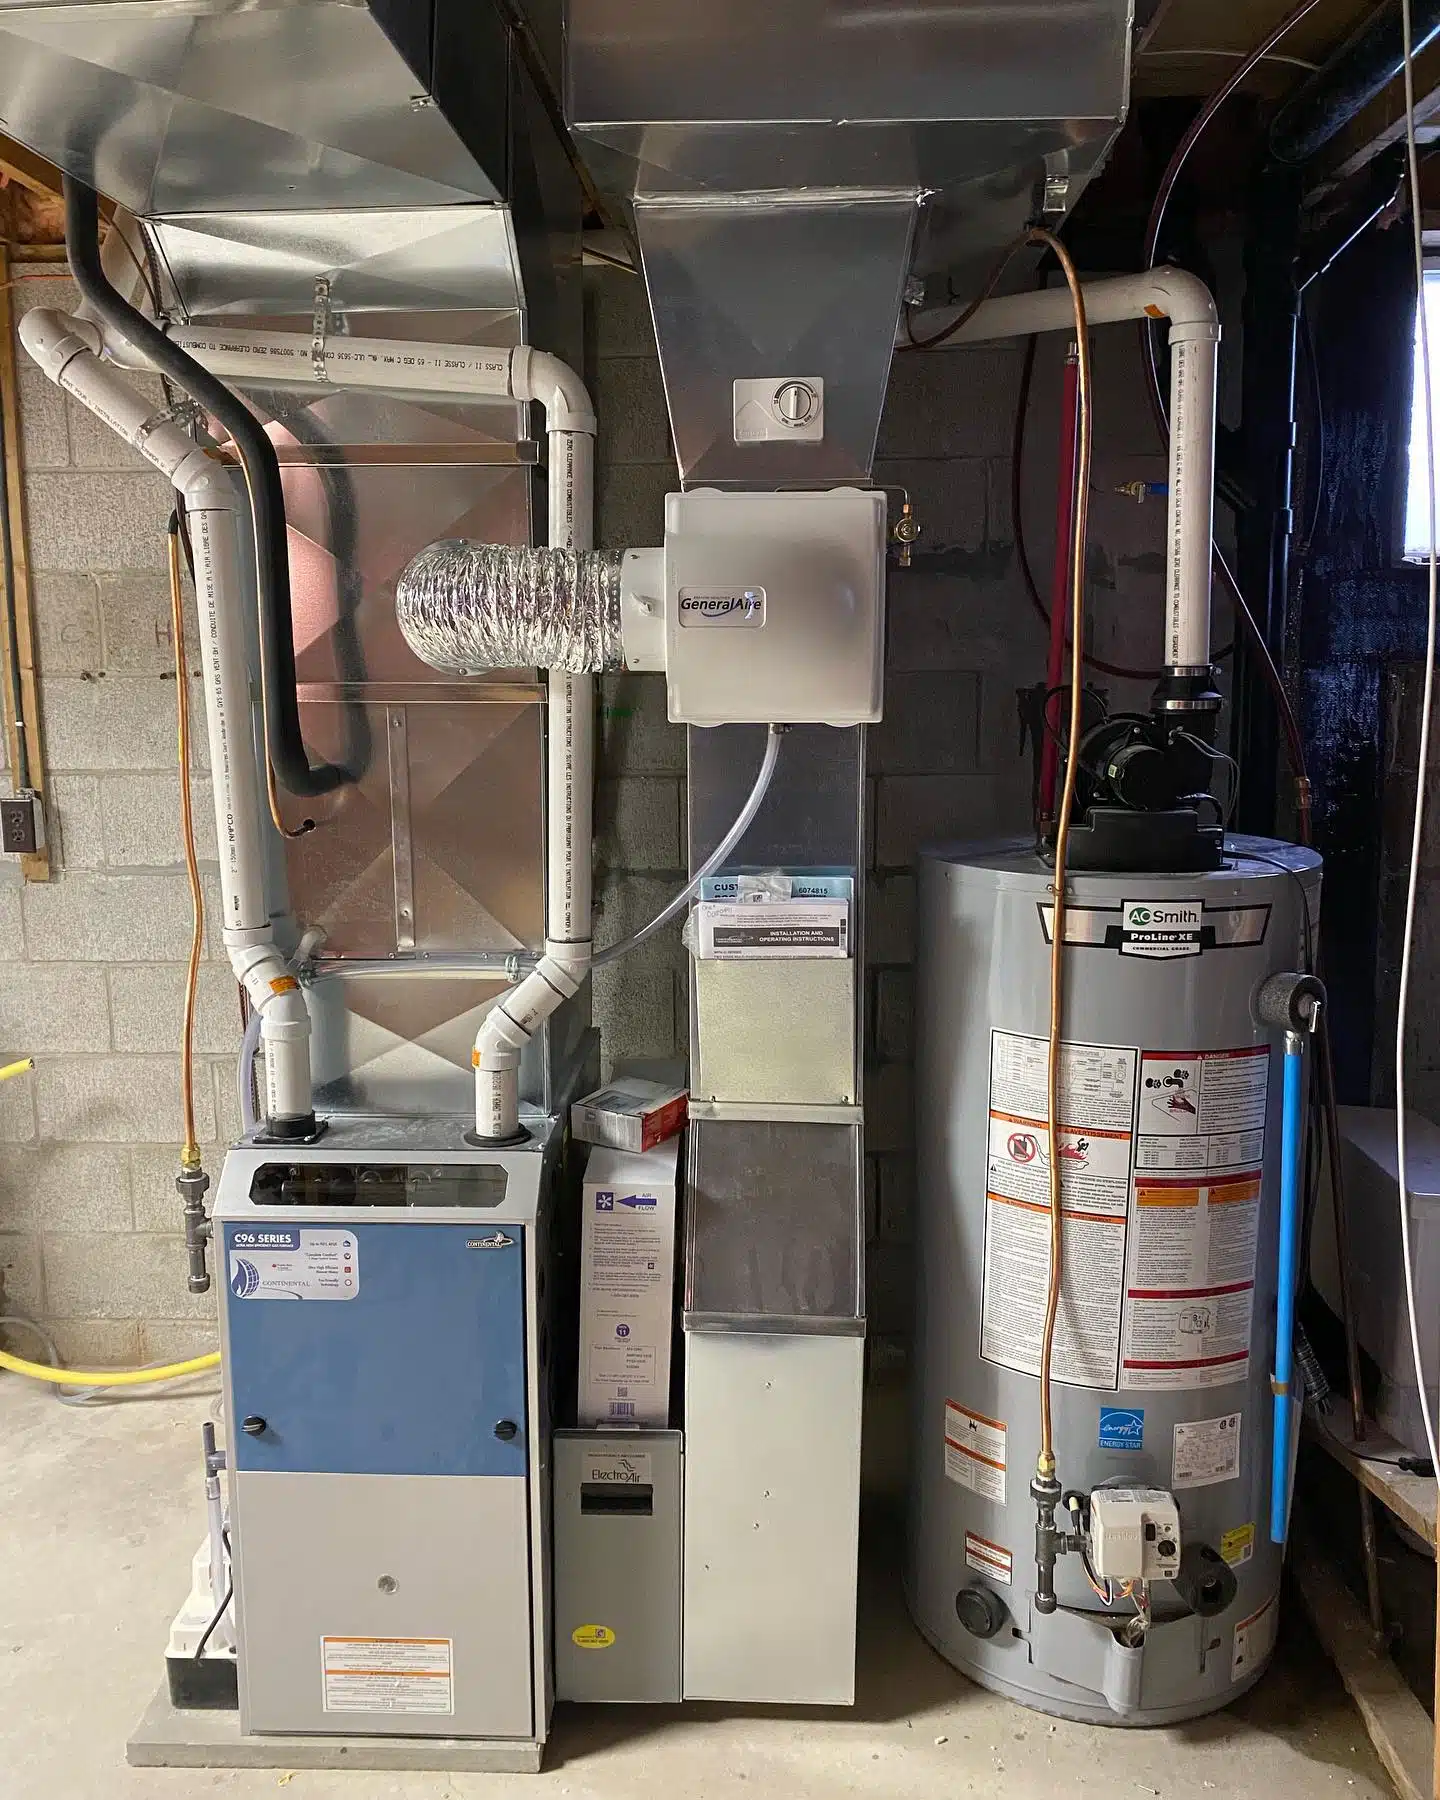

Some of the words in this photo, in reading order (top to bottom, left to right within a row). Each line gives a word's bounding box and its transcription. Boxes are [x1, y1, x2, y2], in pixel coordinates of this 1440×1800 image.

[218, 343, 250, 352] CLEARANCE
[252, 345, 267, 353] ZERO
[444, 360, 465, 368] CLASSE
[484, 363, 502, 371] CLASS
[200, 522, 208, 533] DES
[202, 536, 210, 553] LIBRE
[680, 598, 762, 611] GeneralAire
[208, 610, 217, 638] CONDUITE
[226, 813, 235, 841] NAPCO
[1153, 910, 1197, 923] Smith
[1130, 933, 1174, 941] ProLine
[1068, 1129, 1123, 1139] AVERTISSEMENT
[234, 1234, 255, 1243] C96
[258, 1234, 292, 1243] SERIES
[1100, 1440, 1124, 1448] ENERGY
[592, 1469, 641, 1483] ElectroAir
